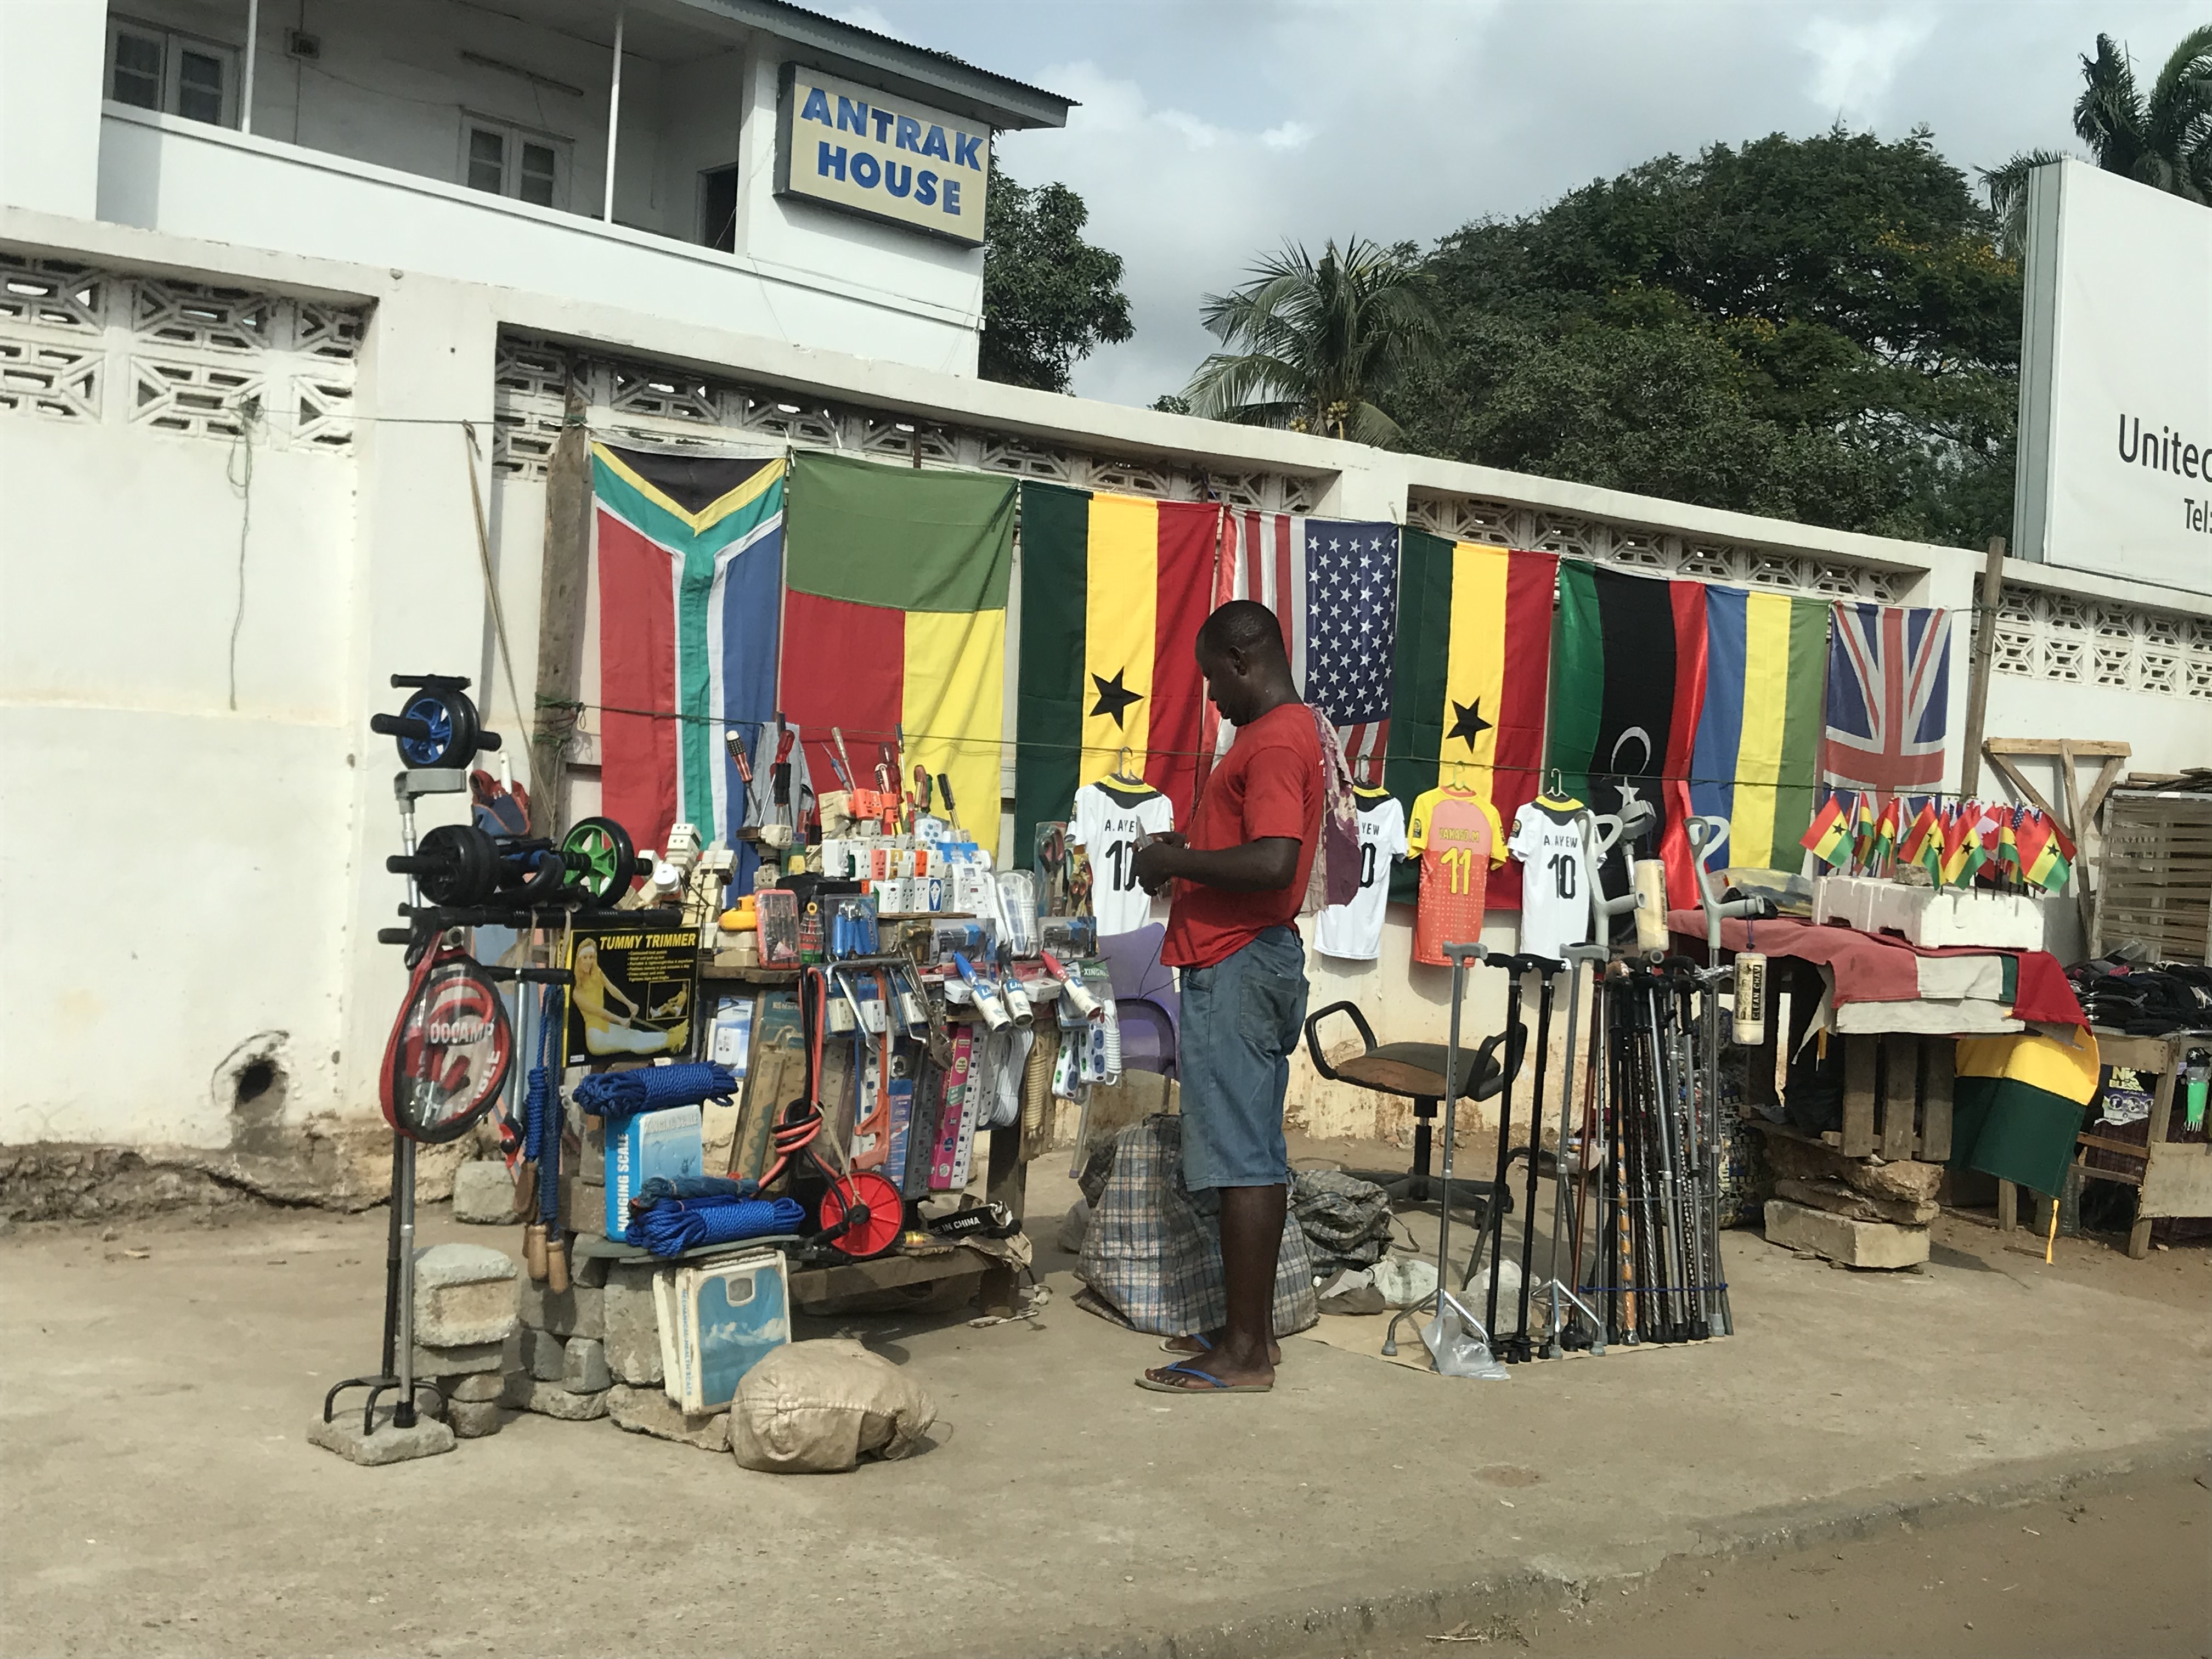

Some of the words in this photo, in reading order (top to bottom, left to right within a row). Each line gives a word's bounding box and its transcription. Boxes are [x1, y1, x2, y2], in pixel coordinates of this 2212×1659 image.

[800, 87, 983, 172] ANTRAK
[818, 141, 961, 216] HOUSE
[1362, 822, 1380, 836] YEW
[1359, 842, 1376, 888] 0
[1441, 847, 1472, 895] 11
[1547, 854, 1576, 900] 10
[600, 935, 642, 950] TUMMY
[645, 933, 696, 948] TRIMMER
[617, 1133, 629, 1172] SCALE
[617, 1175, 629, 1232] HANGING
[941, 1223, 953, 1232] IN
[953, 1216, 981, 1229] CHINA
